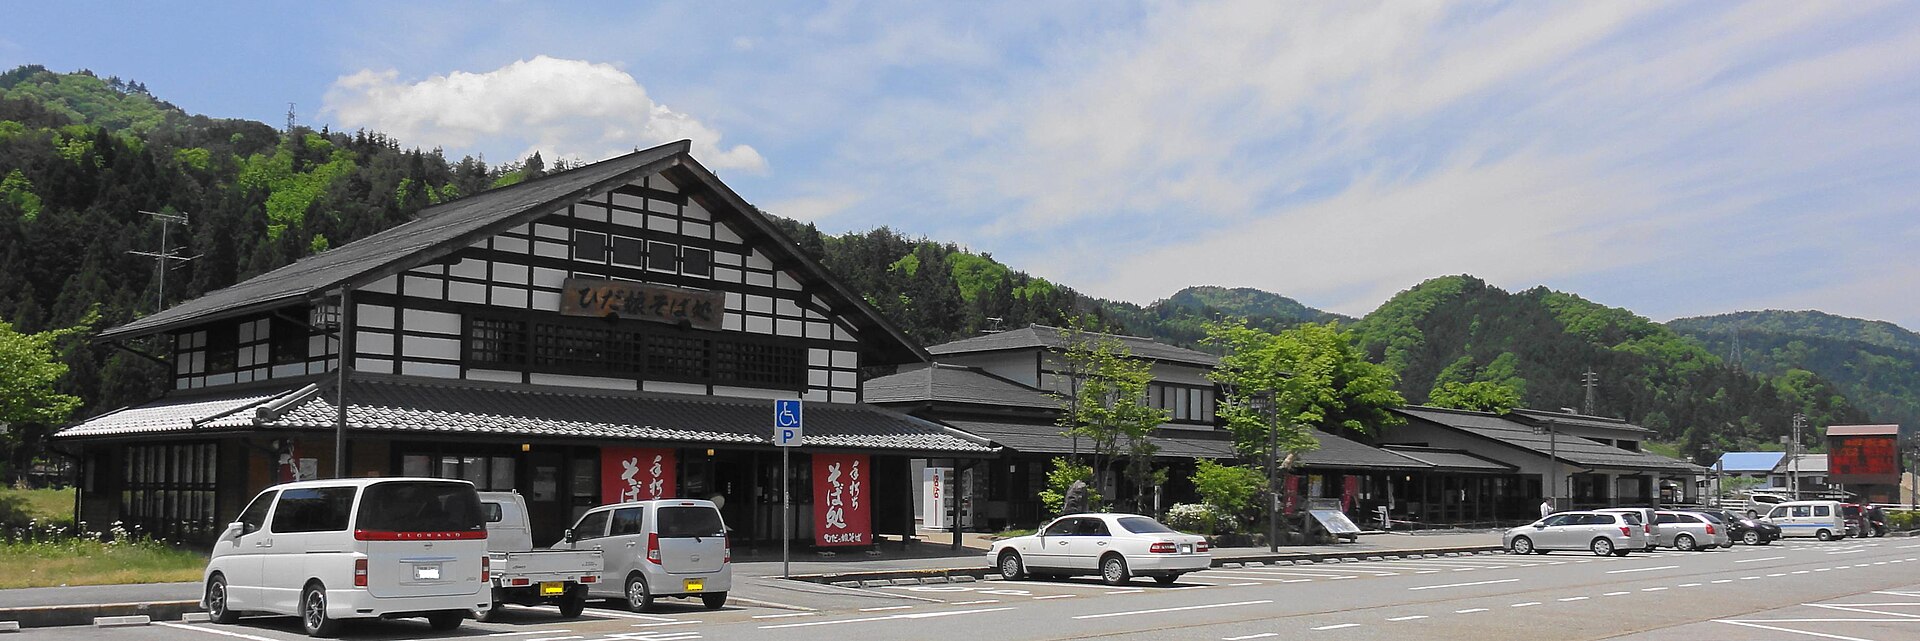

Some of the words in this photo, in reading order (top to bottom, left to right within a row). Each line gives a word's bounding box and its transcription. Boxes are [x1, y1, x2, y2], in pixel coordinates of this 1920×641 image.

[783, 429, 794, 443] P
[825, 462, 847, 529] そば処
[849, 460, 860, 510] 手打ち
